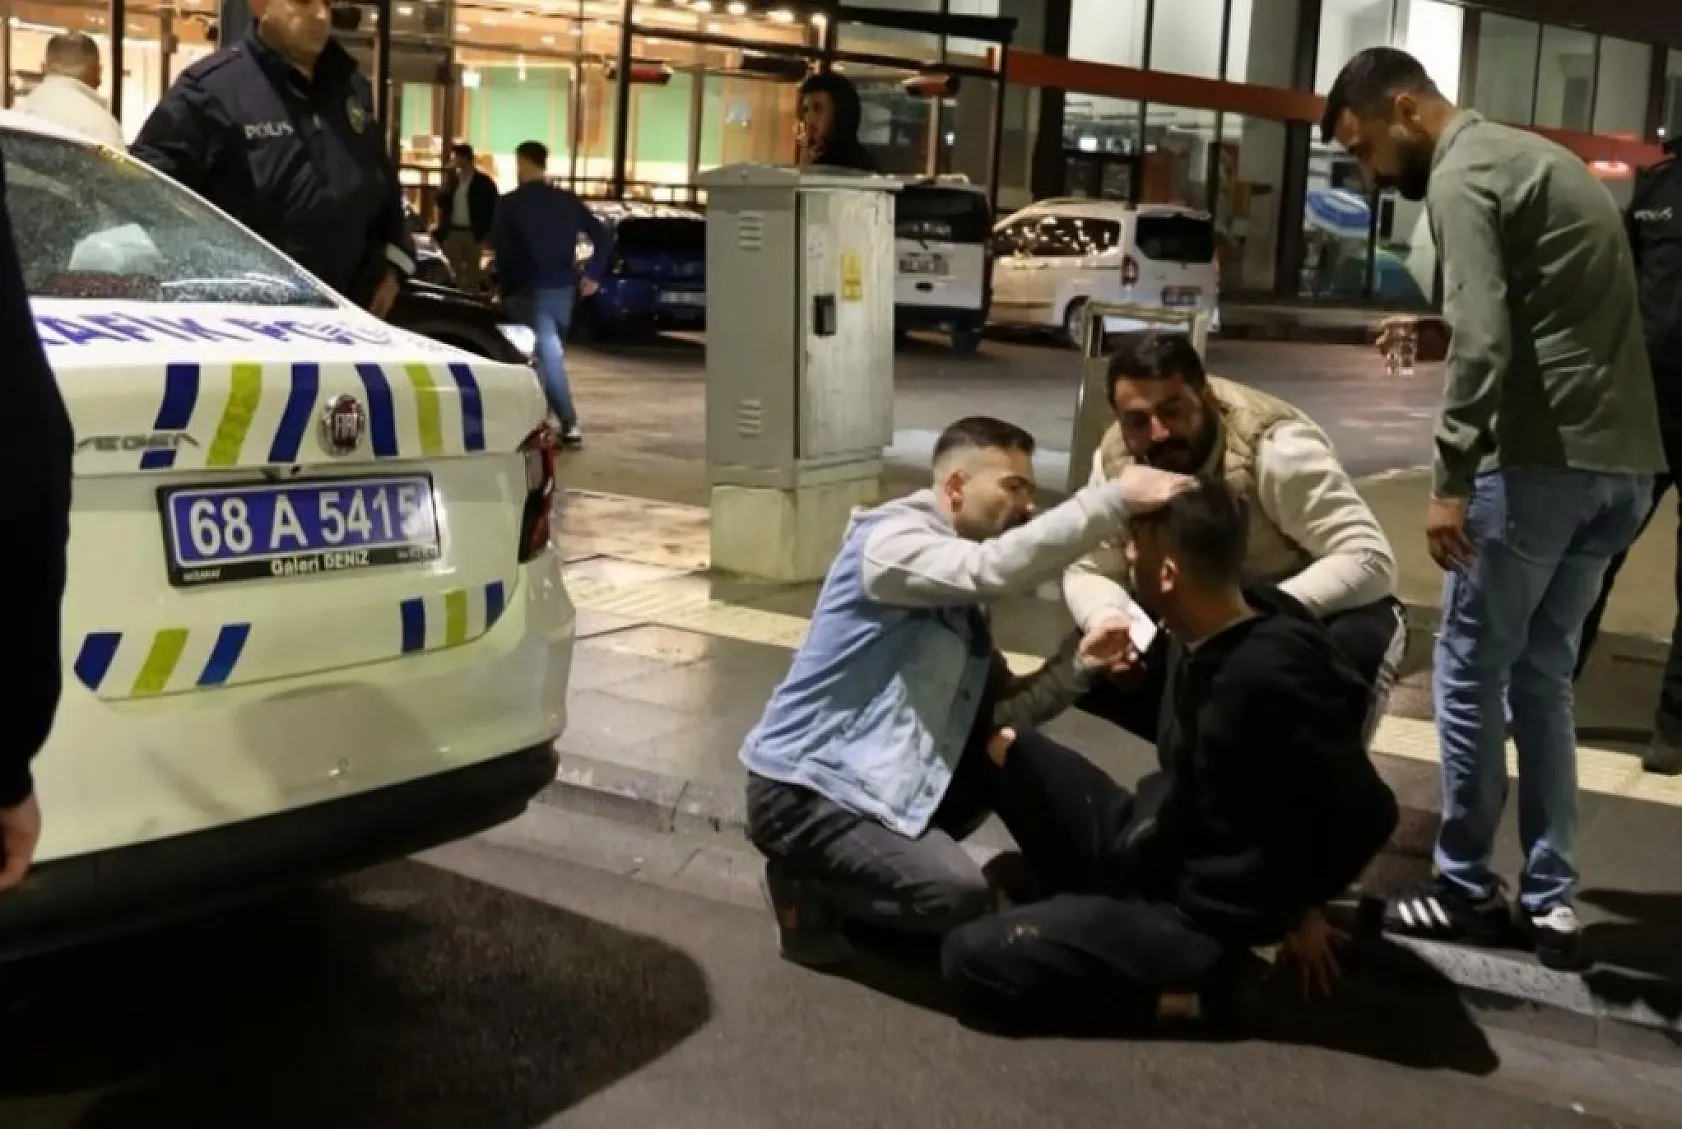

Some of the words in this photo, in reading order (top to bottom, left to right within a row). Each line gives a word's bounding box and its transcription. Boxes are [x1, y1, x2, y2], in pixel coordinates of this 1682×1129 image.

[189, 498, 253, 557] 68
[269, 493, 308, 550] A
[318, 486, 424, 544] 5415
[270, 555, 320, 577] Galeri
